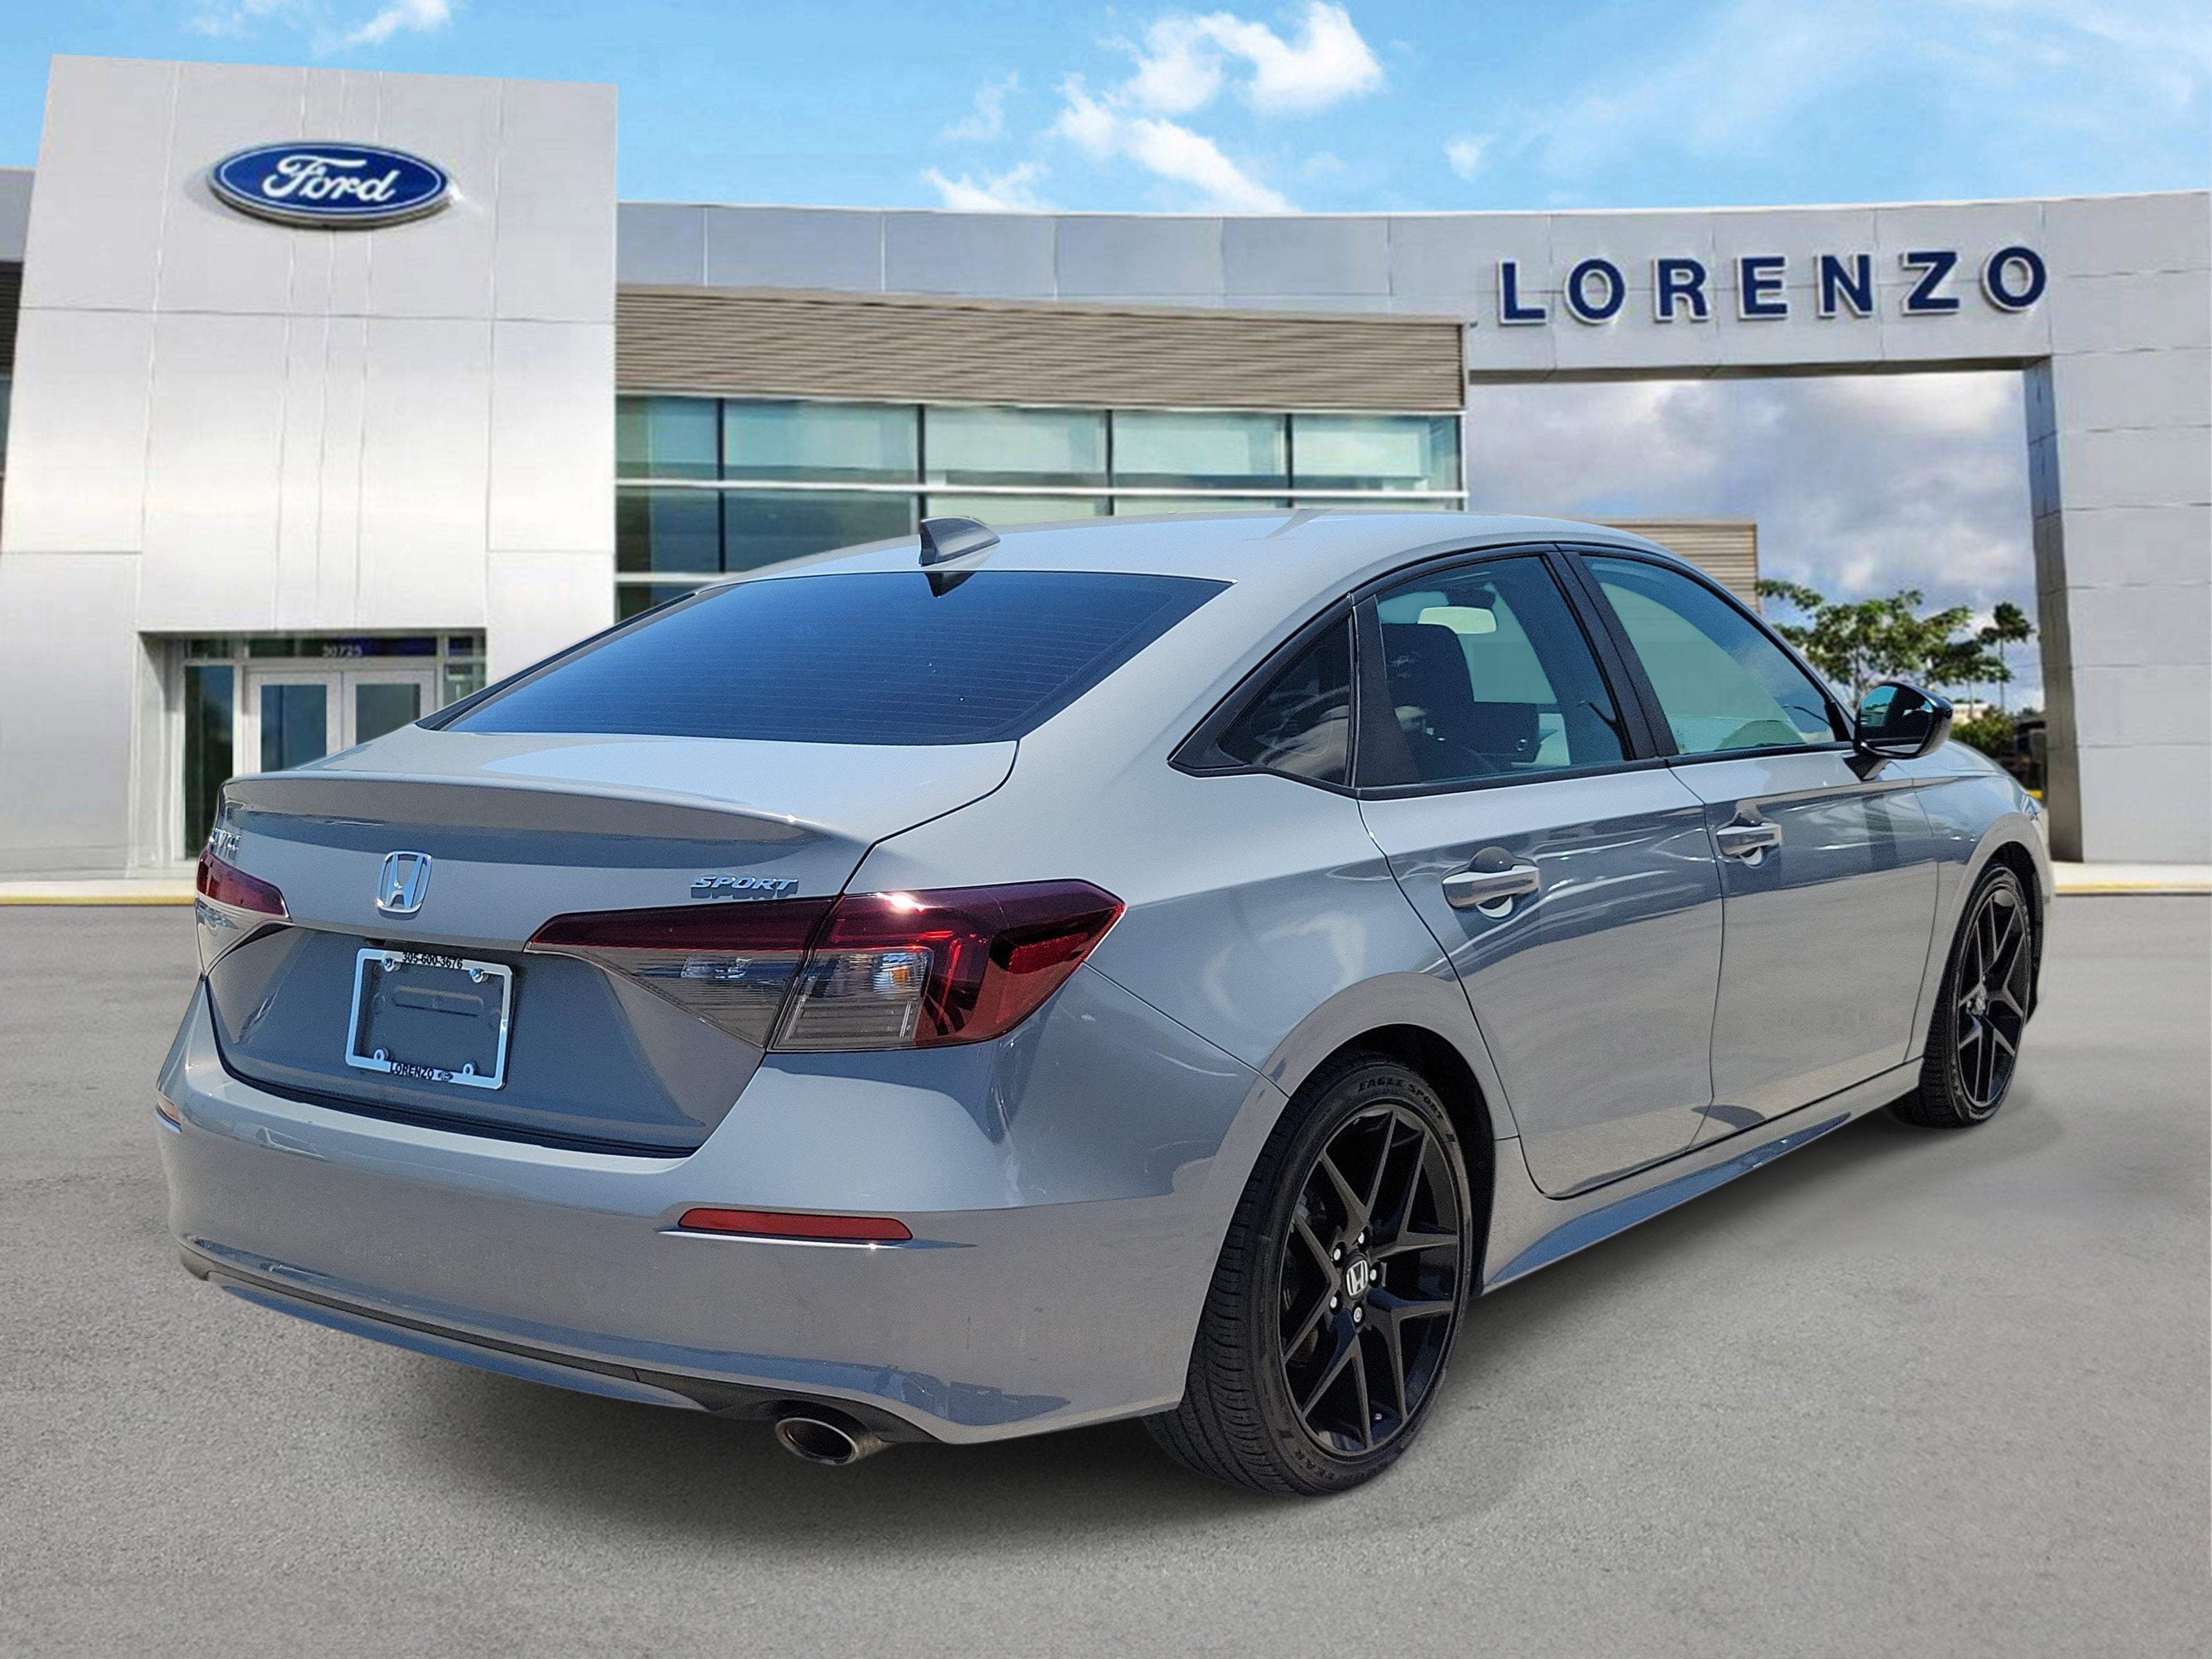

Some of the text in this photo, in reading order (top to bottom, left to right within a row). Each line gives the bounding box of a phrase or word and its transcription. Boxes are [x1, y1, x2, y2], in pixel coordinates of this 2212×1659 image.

[262, 154, 400, 201] Ford
[1498, 246, 2047, 325] LORENZO
[691, 876, 799, 891] SPORT
[402, 952, 463, 970] 305-600-3676
[390, 1062, 434, 1080] LORENZO
[1358, 1077, 1444, 1119] EAGLE SPORT
